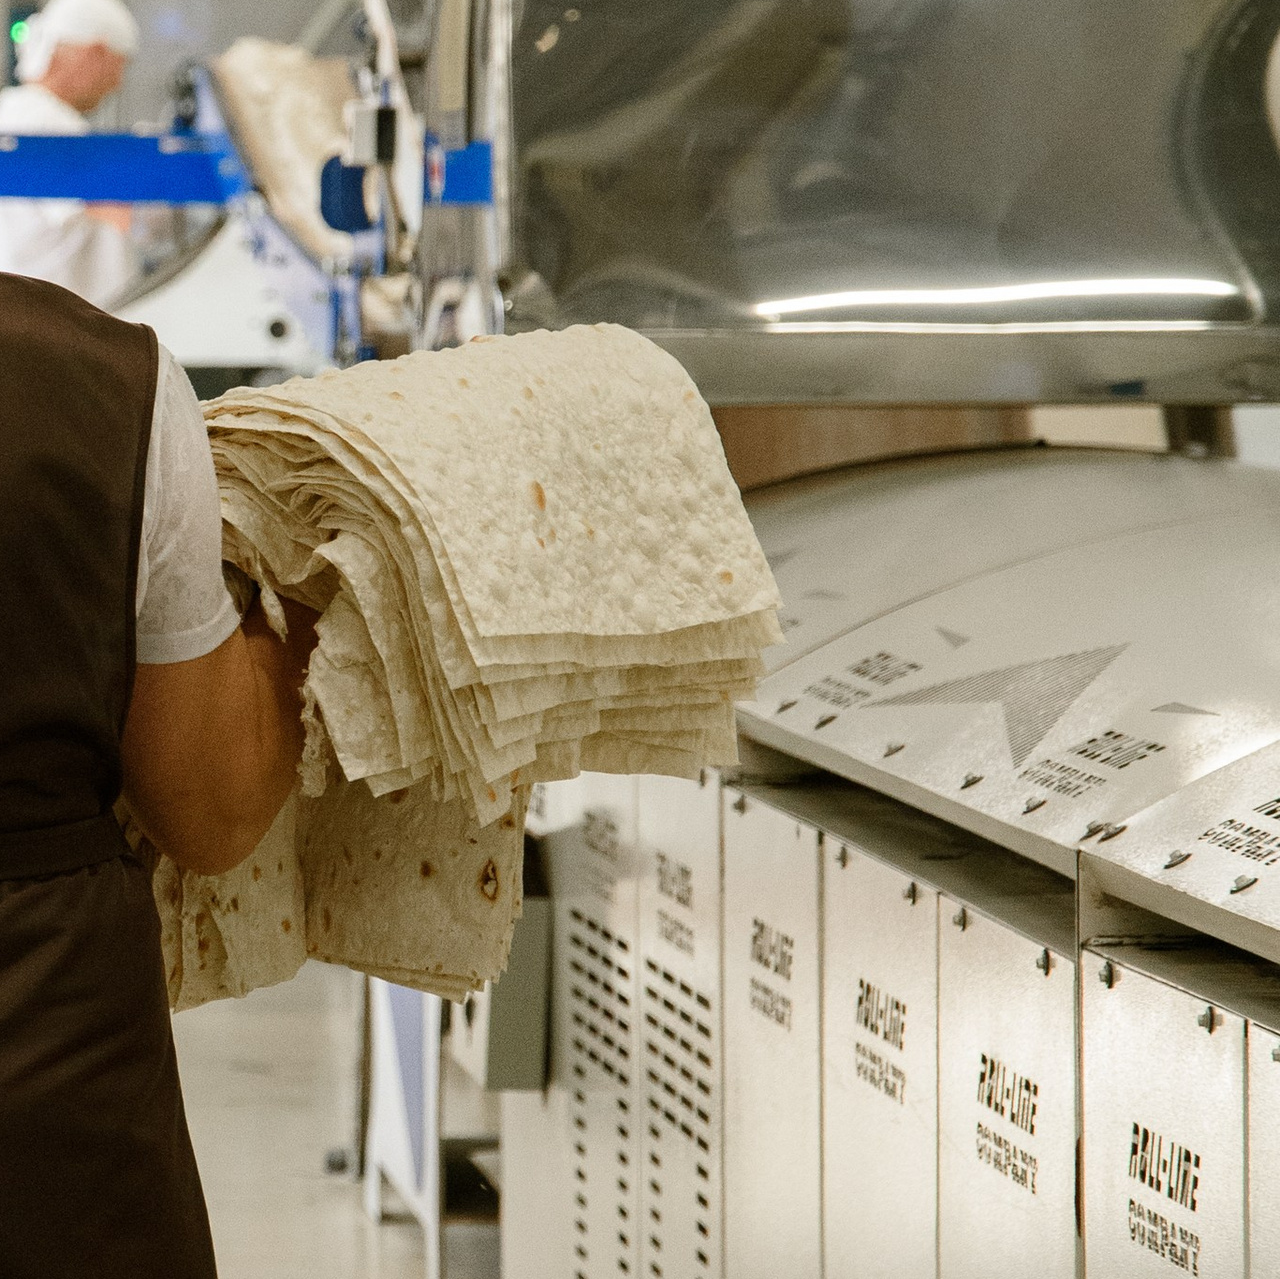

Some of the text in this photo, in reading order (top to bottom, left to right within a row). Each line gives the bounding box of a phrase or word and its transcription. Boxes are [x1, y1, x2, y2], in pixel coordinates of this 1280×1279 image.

[856, 978, 906, 1050] ROLL-LINE
[977, 1053, 1038, 1136] ROLL-LINE
[1128, 1122, 1200, 1212] ROLL-LINE
